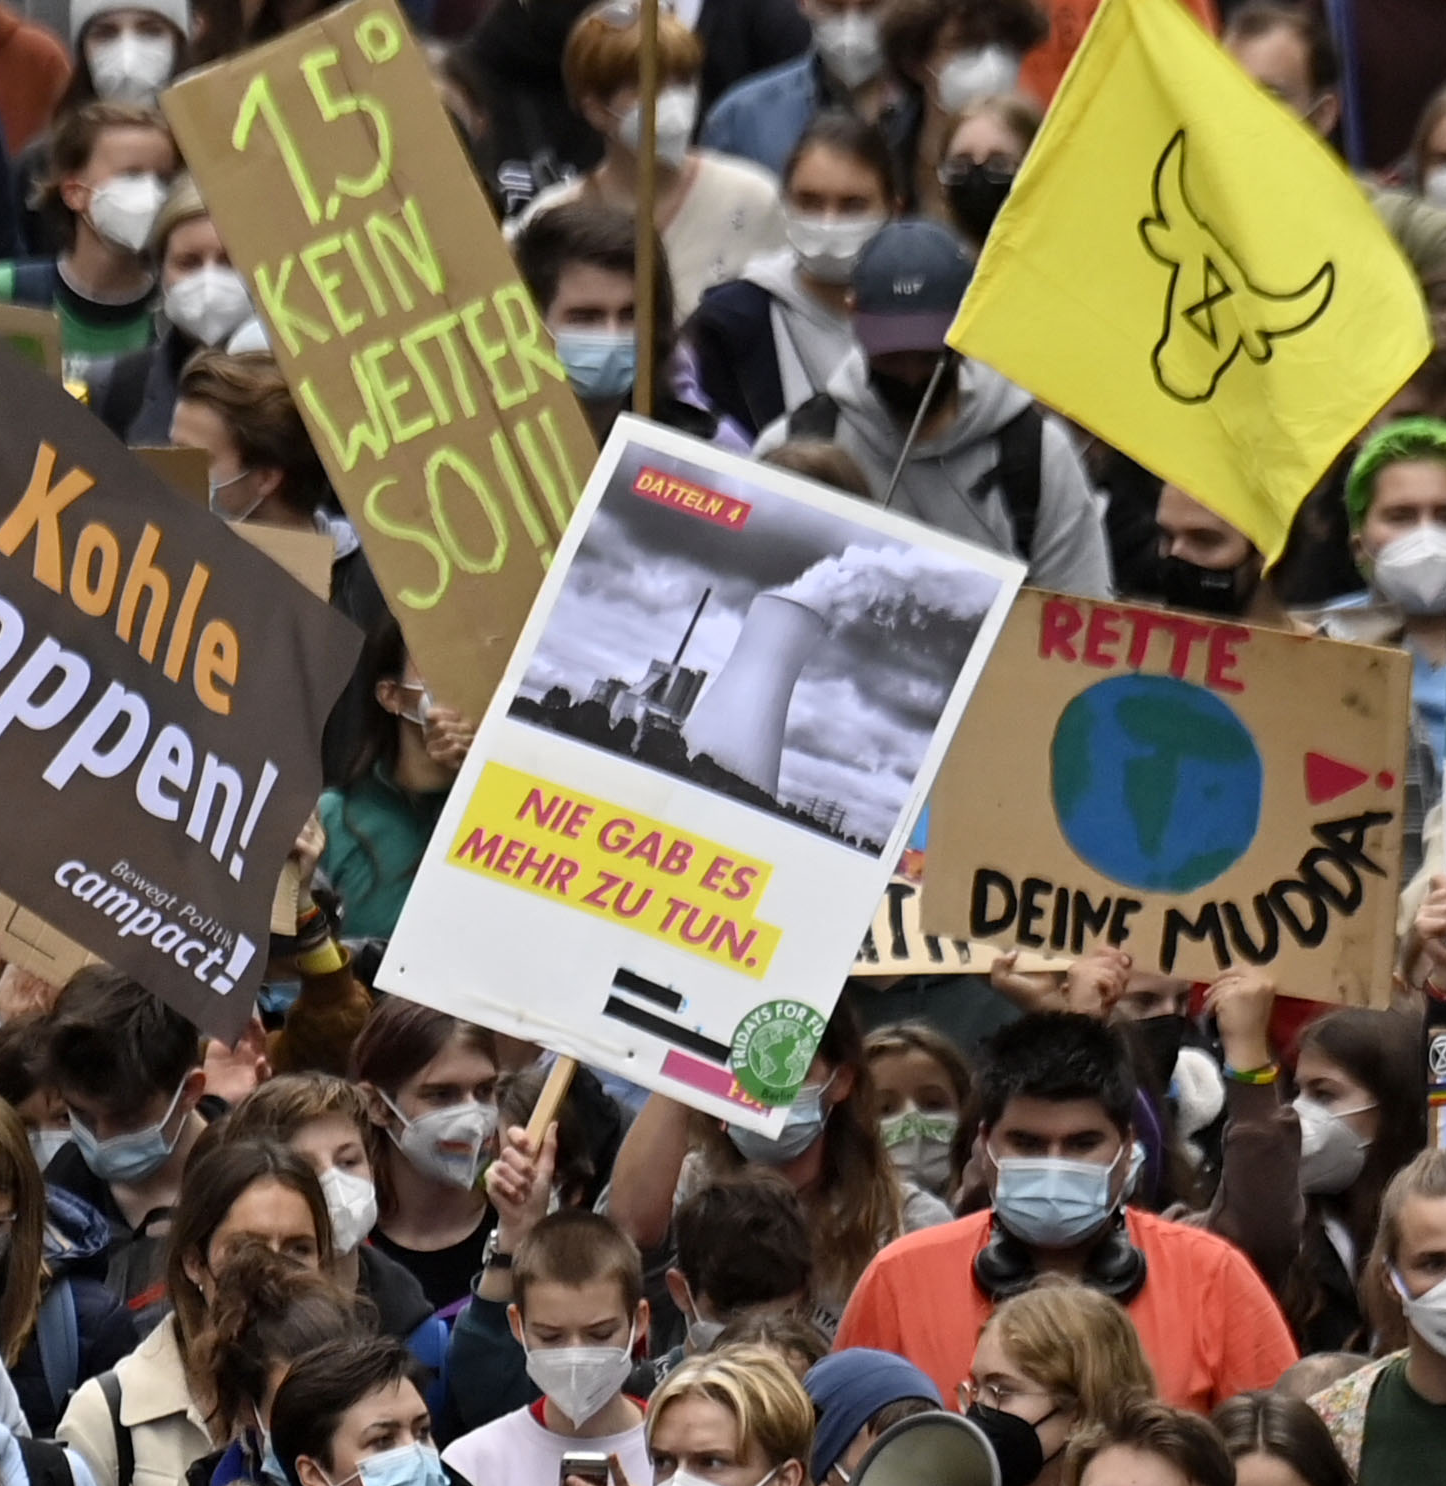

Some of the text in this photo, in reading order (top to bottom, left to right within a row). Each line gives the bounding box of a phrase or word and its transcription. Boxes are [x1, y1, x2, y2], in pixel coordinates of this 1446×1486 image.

[252, 198, 444, 360] KEIN
[298, 283, 567, 473] WEITER
[634, 470, 743, 524] DATTELN 4
[1038, 599, 1252, 694] RETTE
[515, 787, 761, 902] NIE GAB ES
[54, 859, 257, 997] campact!
[110, 858, 238, 952] Bewegt Politik
[455, 826, 761, 970] MEHR ZU TUN.
[969, 867, 1142, 955] DEINE
[732, 1006, 772, 1070] FRIDAYS
[775, 1002, 808, 1022] FOR
